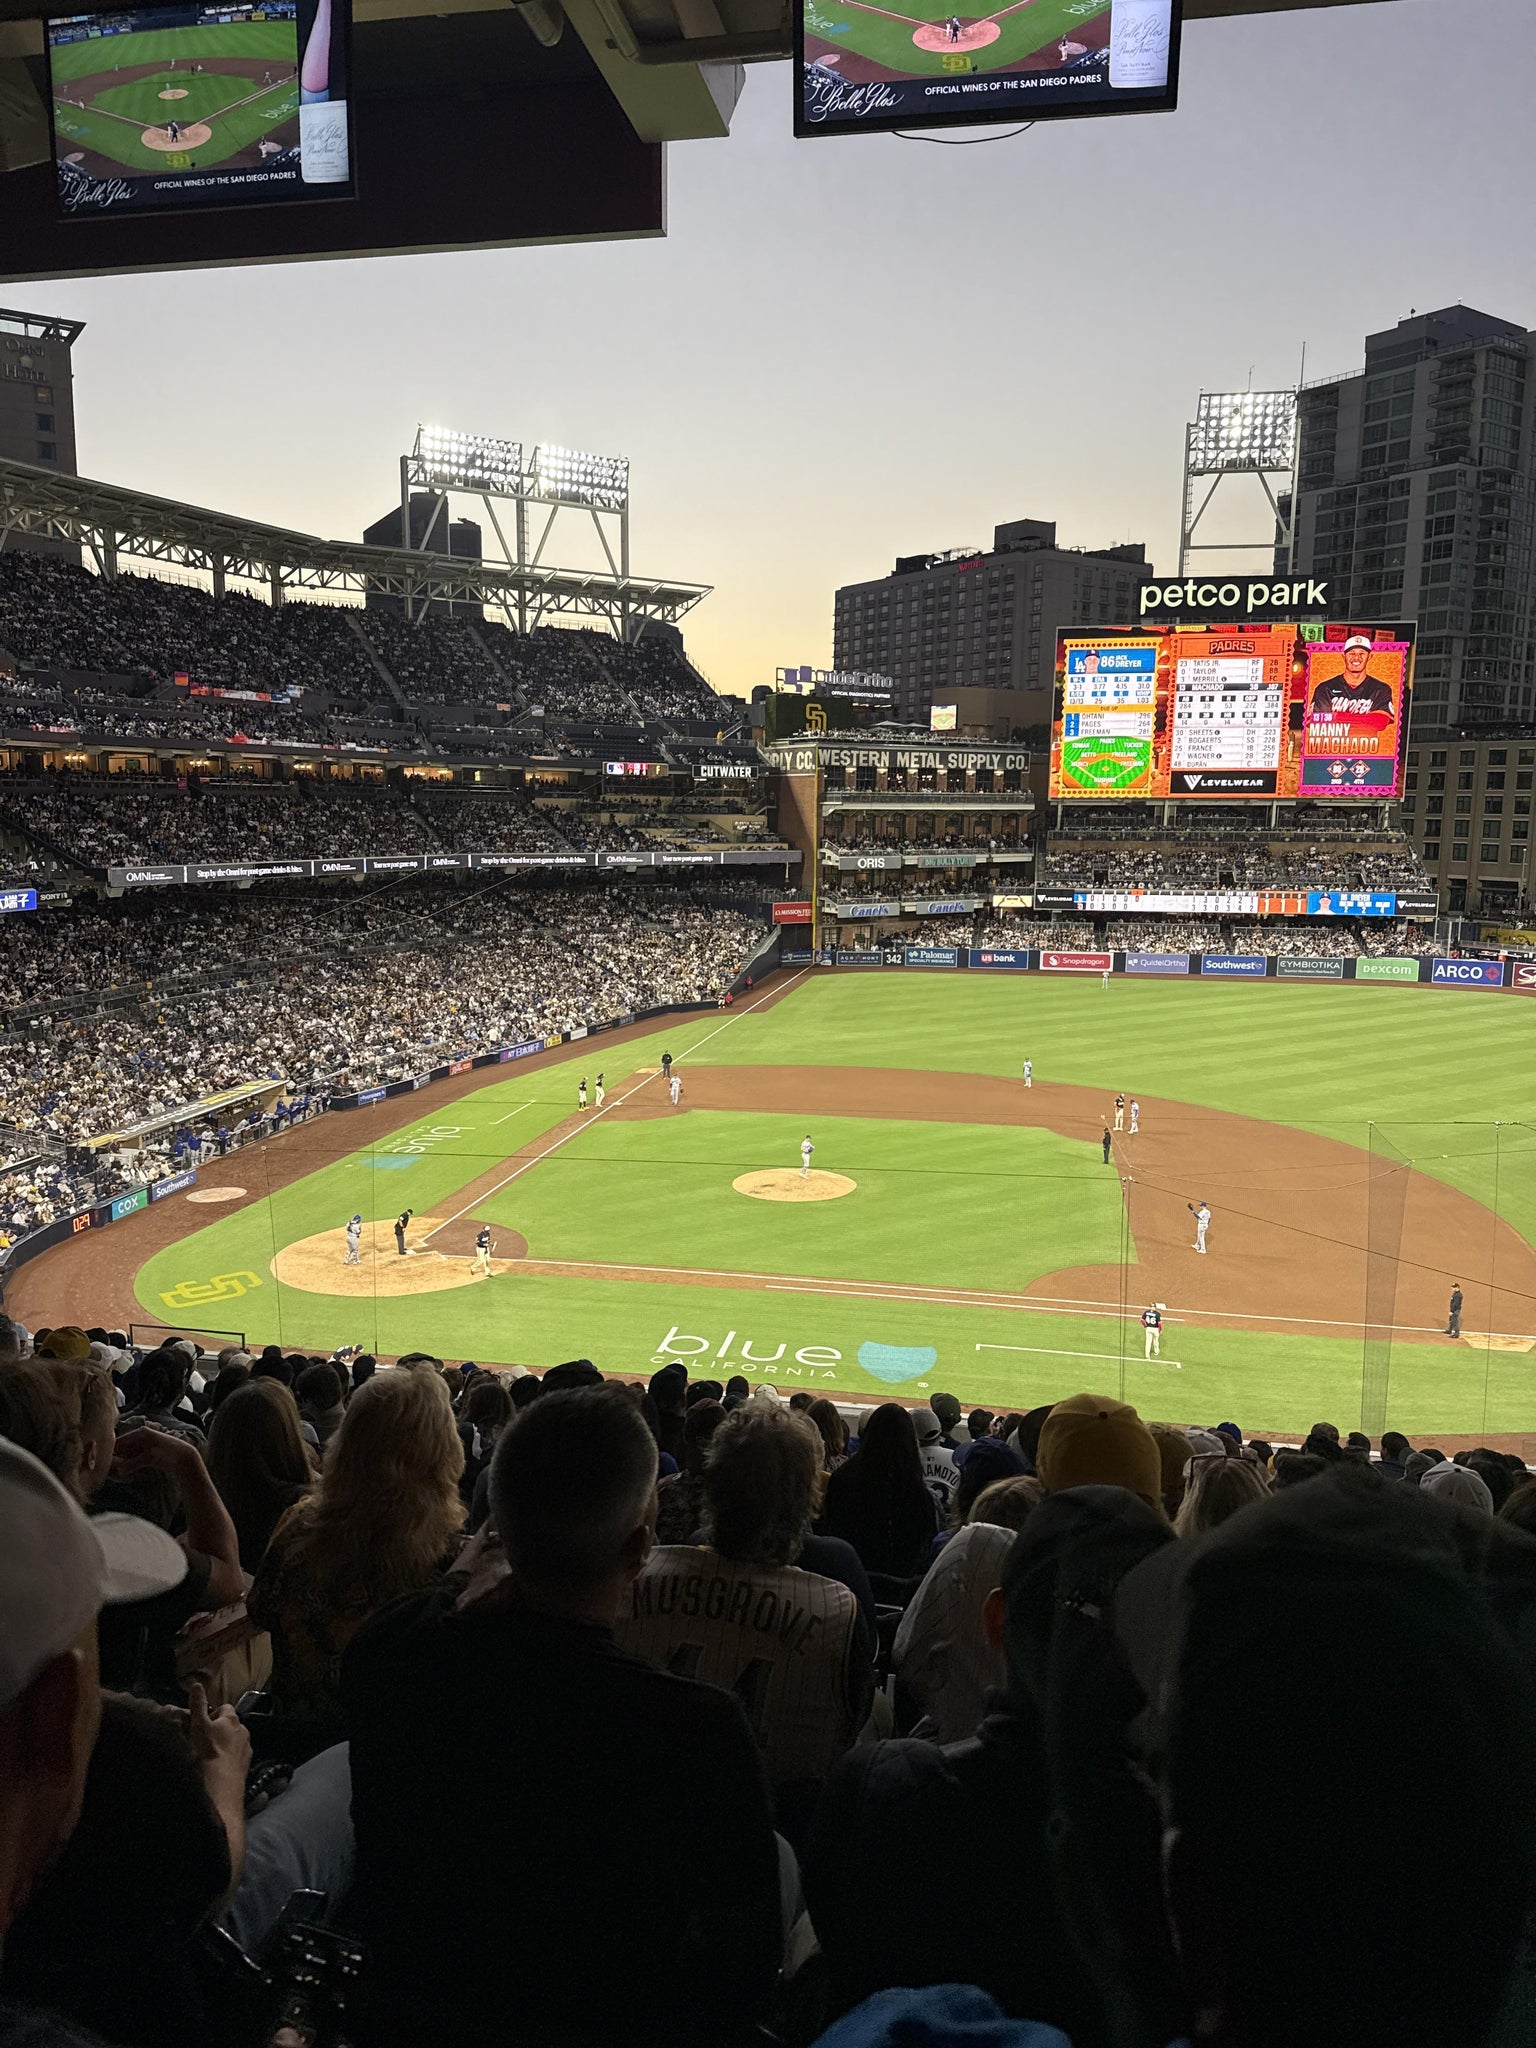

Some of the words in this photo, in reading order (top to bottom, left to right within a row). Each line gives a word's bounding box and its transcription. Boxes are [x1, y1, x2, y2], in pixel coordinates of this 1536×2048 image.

[925, 86, 960, 95] OFFICIAL
[962, 83, 988, 92] WINES
[990, 82, 1001, 90] OF
[1003, 80, 1018, 89] THE
[1020, 79, 1037, 88] SAN
[1040, 77, 1067, 86] DIEGO
[1069, 74, 1102, 84] PADRES
[804, 83, 865, 122] Belle
[855, 83, 904, 116] Glos
[184, 179, 205, 187] WINES
[246, 174, 269, 182] DIEGO
[1140, 579, 1240, 615] petco
[1247, 579, 1328, 613] park
[1209, 641, 1255, 654] PADRES
[1101, 656, 1115, 667] 86
[1309, 723, 1350, 736] MANNY
[1308, 737, 1379, 754] MACHADO
[796, 752, 816, 770] CO.
[819, 749, 889, 767] WESTERN
[897, 751, 943, 768] METAL
[948, 754, 1000, 769] SUPPLY
[1005, 755, 1028, 770] CO.
[701, 767, 751, 777] CUTWATER
[607, 854, 626, 862] OMNI
[858, 858, 885, 868] ORIS
[226, 868, 239, 876] Omni
[322, 864, 340, 872] OMNI
[126, 871, 151, 882] OMNI
[0, 894, 29, 910] 端子
[823, 916, 836, 924] 336
[886, 954, 902, 963] 342
[921, 951, 954, 959] Palomar
[981, 954, 992, 962] us
[993, 954, 1015, 962] bank
[1062, 958, 1105, 966] Snapdragon
[1140, 959, 1186, 967] QuidelOrtho
[1206, 961, 1256, 970] Southwest
[1280, 961, 1340, 969] CYMBIOTIKA
[1434, 966, 1482, 979] ARCO
[393, 1126, 476, 1154] blue
[156, 1176, 189, 1198] Southwest
[118, 1196, 138, 1213] COX
[73, 1214, 90, 1232] 029
[656, 1326, 842, 1367] blue
[649, 1356, 836, 1378] CALIFORNIA
[632, 1574, 824, 1657] MUSGROVE
